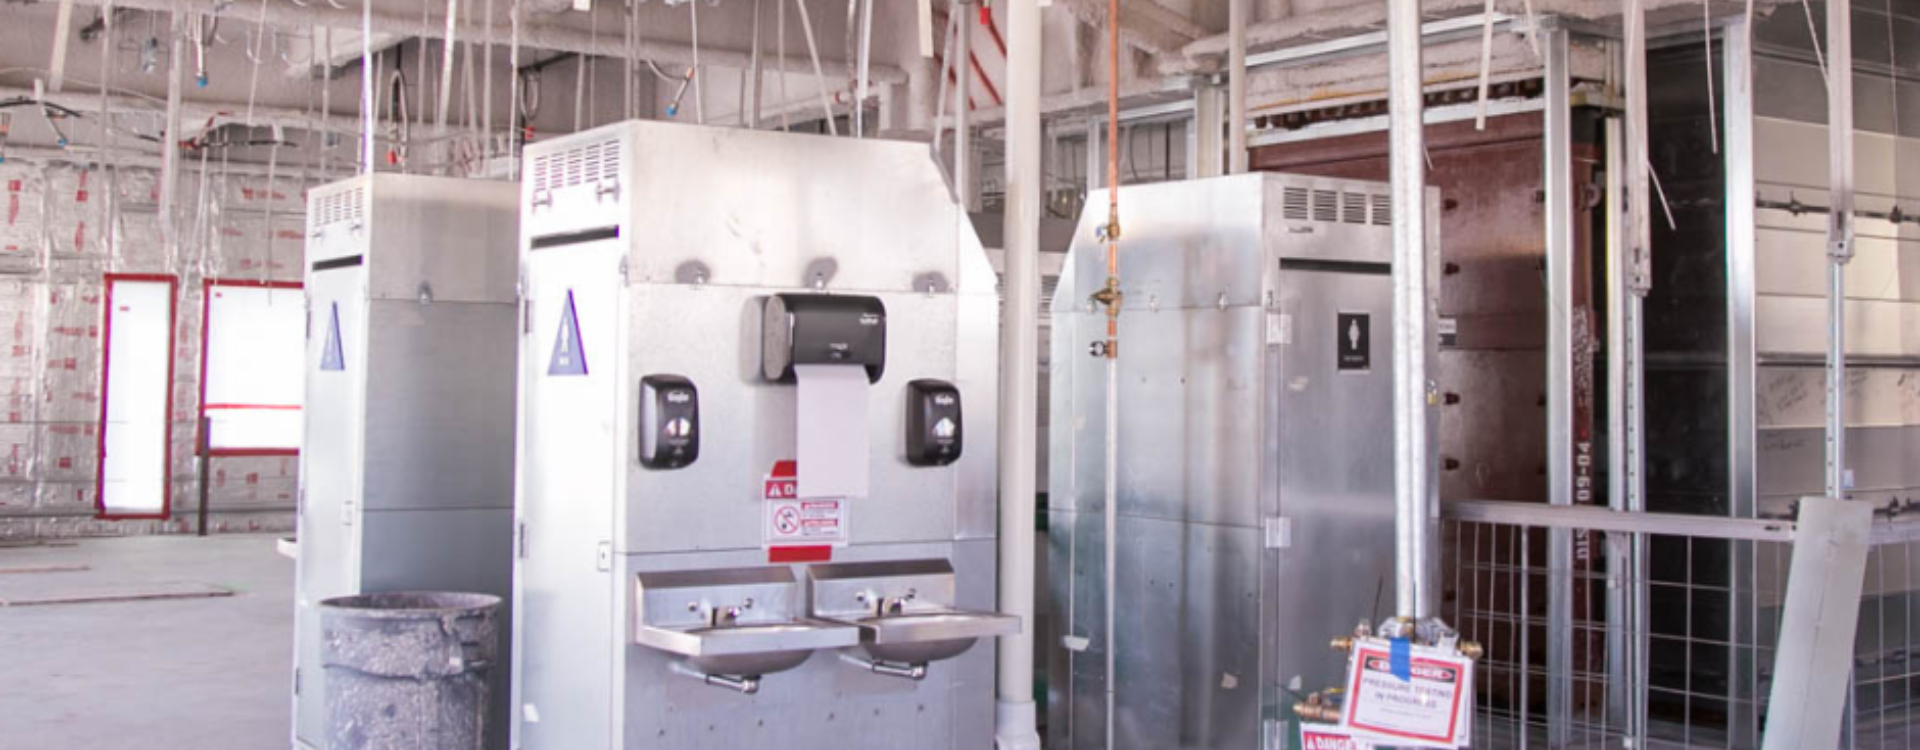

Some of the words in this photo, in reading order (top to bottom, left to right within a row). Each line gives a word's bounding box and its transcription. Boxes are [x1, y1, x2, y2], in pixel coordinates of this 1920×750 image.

[1576, 443, 1591, 501] 09-04
[1377, 660, 1442, 677] DGER
[1362, 678, 1411, 692] PRESSURE
[1414, 686, 1455, 699] TESTING
[1374, 691, 1385, 701] IN
